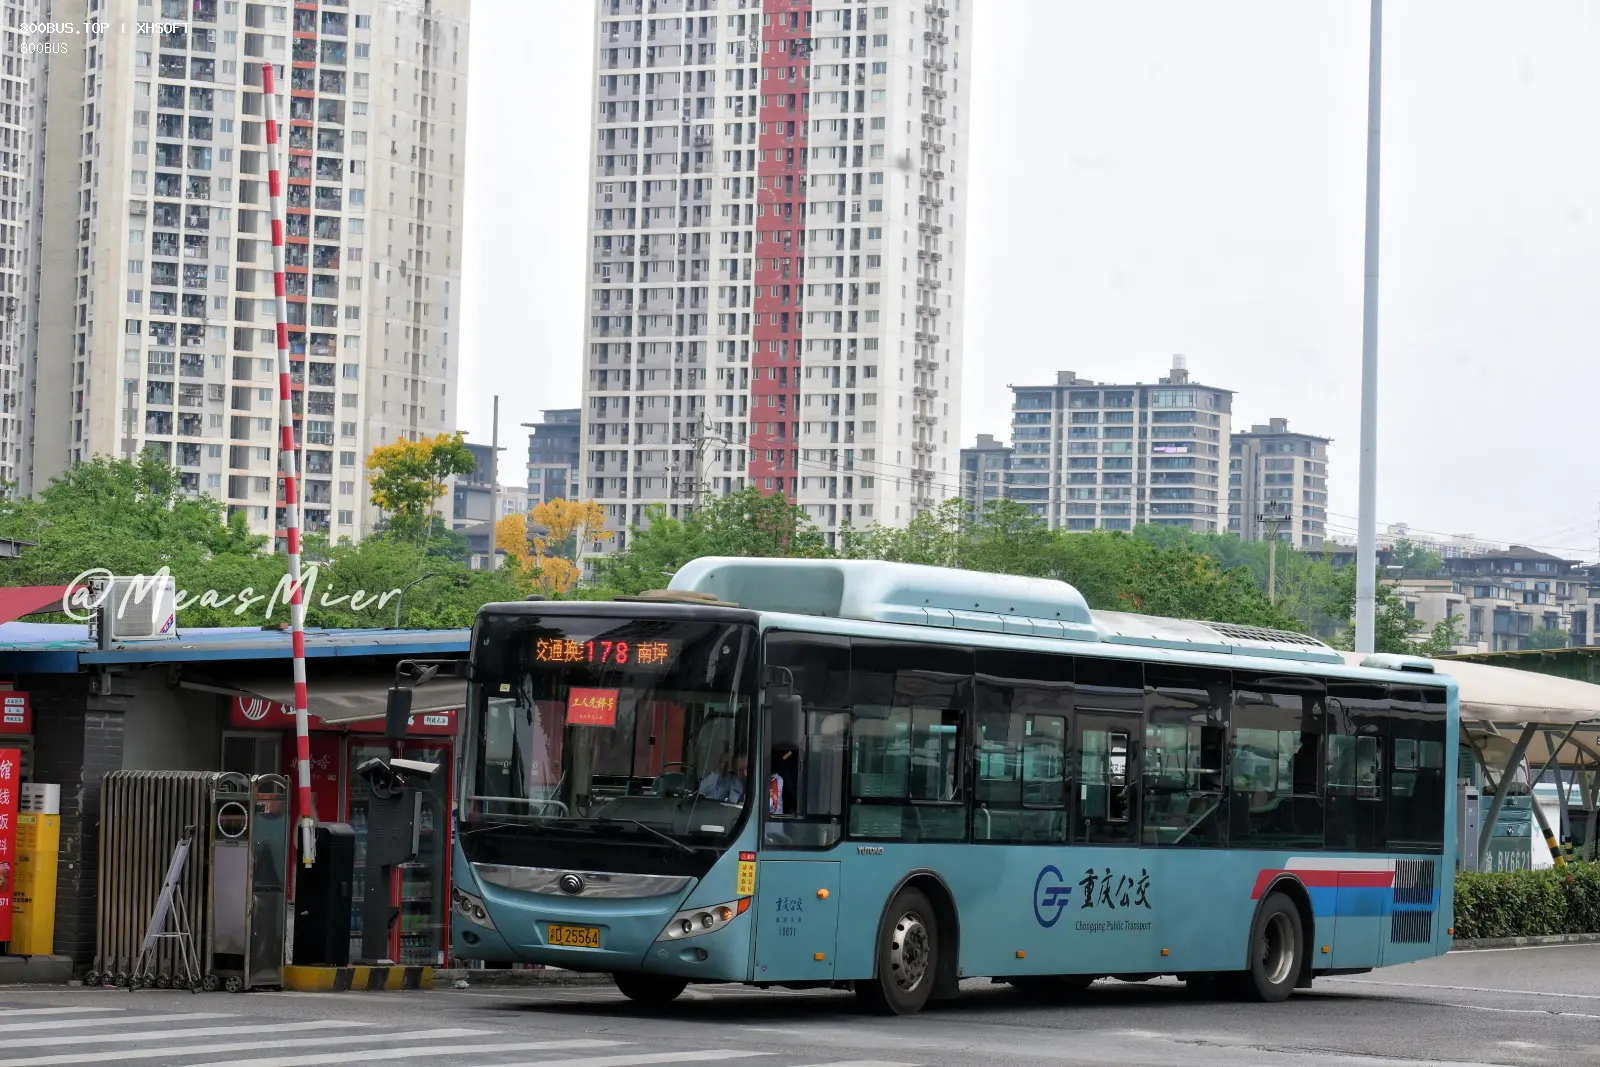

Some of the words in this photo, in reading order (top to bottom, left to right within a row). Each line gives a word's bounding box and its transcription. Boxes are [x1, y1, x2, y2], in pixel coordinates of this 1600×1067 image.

[586, 640, 629, 664] 178
[637, 641, 668, 665] 南坪
[571, 696, 614, 711] 工人先锋号
[1079, 867, 1152, 909] 重庆公交
